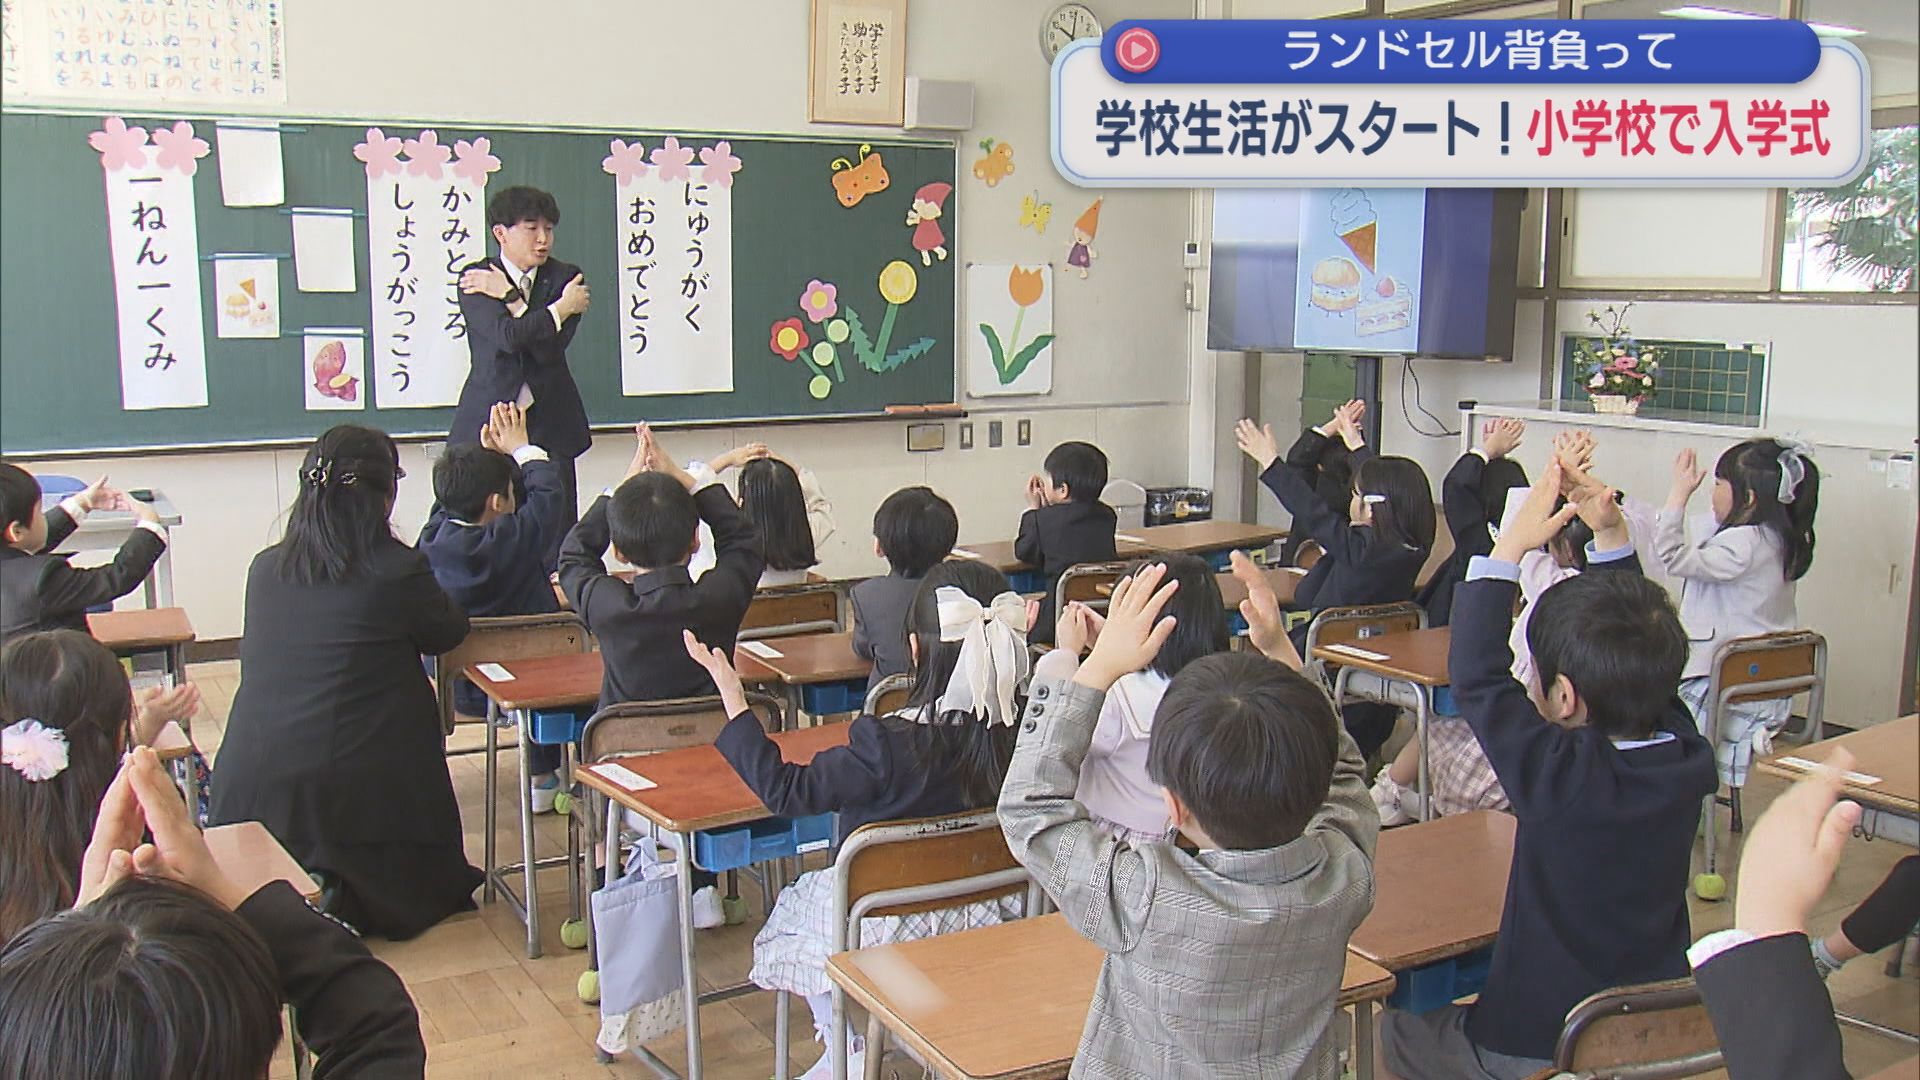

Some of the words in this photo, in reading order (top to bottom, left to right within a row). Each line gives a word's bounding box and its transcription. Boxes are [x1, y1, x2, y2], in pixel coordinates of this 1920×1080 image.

[118, 0, 139, 90] みむめも
[140, 0, 160, 89] ひふへほ
[128, 177, 178, 371] 一ねん一くみ
[387, 183, 418, 392] しょうがっこう
[626, 197, 657, 354] おめでとう
[681, 183, 710, 332] にゅうがく
